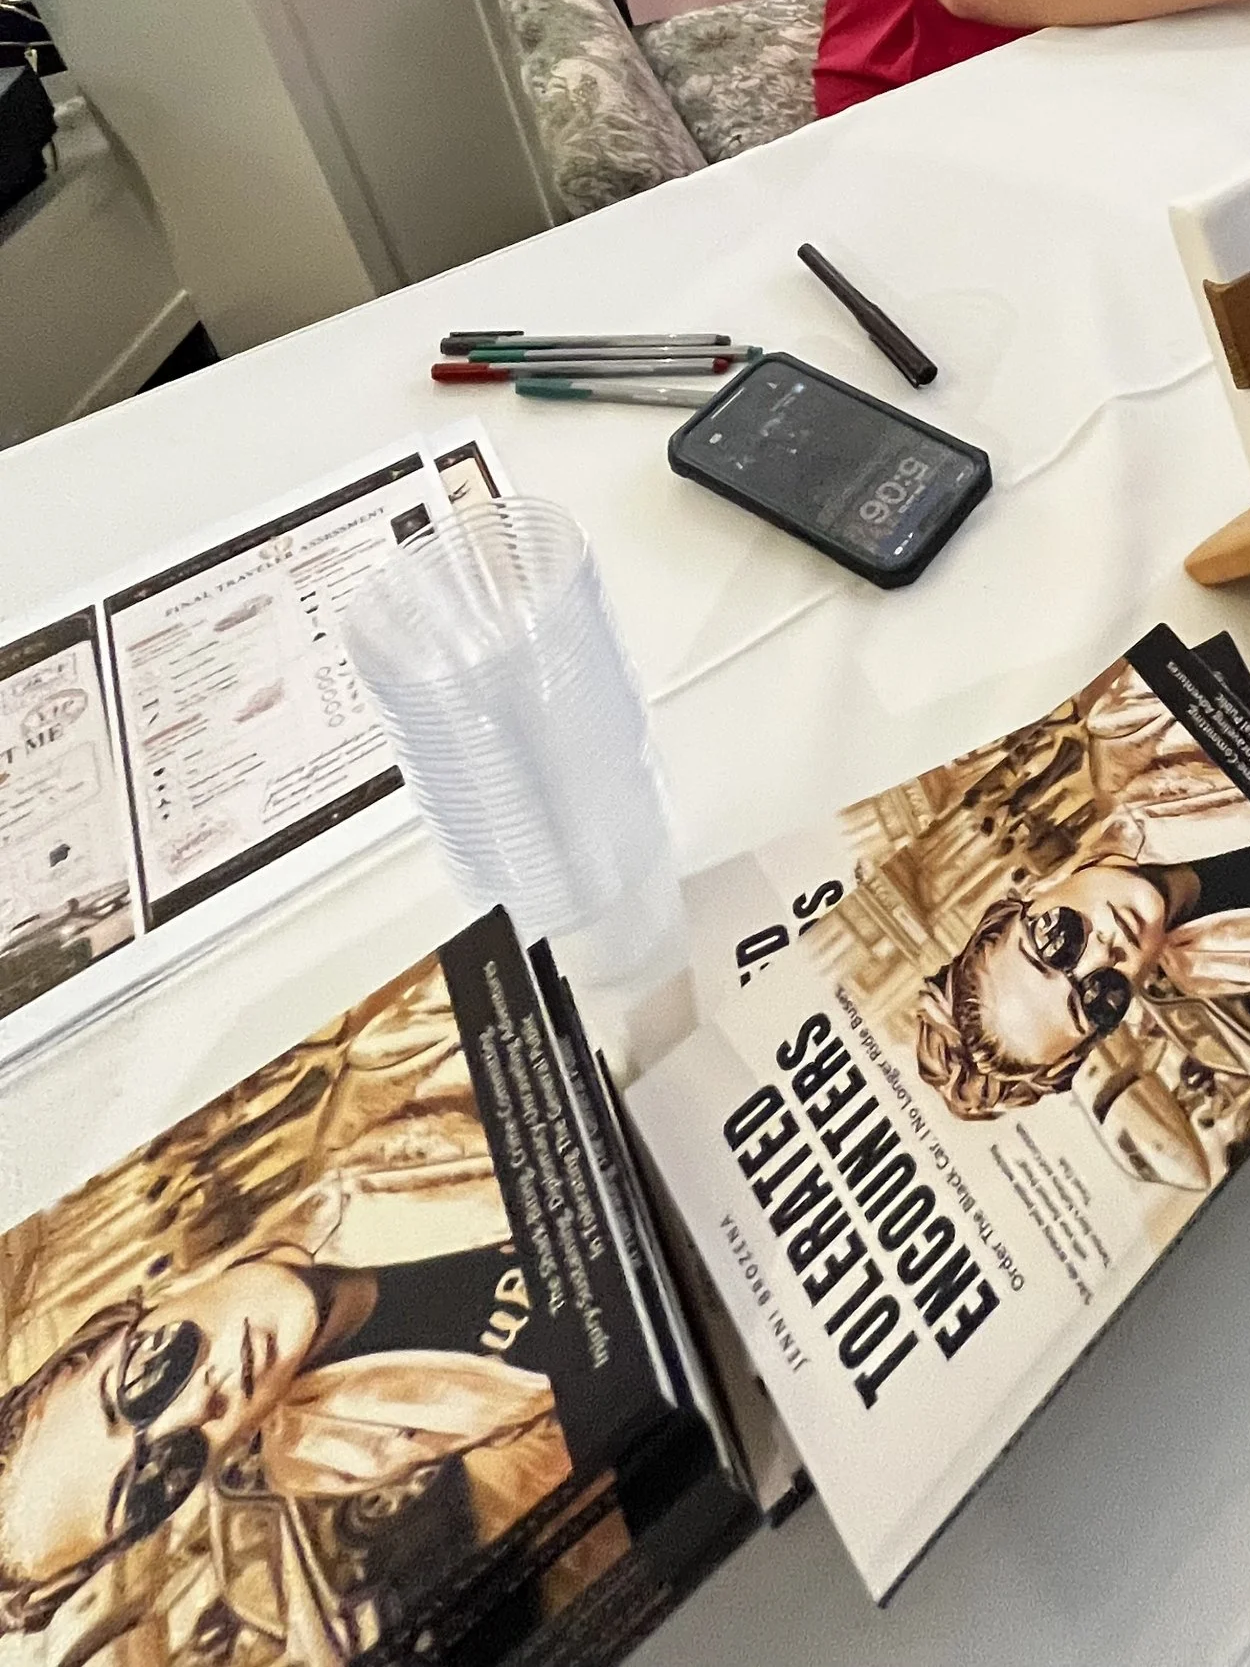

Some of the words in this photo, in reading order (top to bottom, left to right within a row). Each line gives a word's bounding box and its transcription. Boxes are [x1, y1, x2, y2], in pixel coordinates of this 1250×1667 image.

[859, 456, 929, 522] 5:06
[1166, 659, 1214, 715] Adventures
[1214, 691, 1245, 725] Public
[855, 1025, 884, 1061] Ride
[875, 1056, 916, 1110] Longer
[904, 1106, 927, 1132] No
[770, 1010, 1002, 1357] ENCOUNTERS
[941, 1166, 978, 1212] Black
[718, 1081, 920, 1409] TOLERATED
[968, 1209, 998, 1244] The
[986, 1239, 1029, 1292] Order
[542, 1275, 570, 1313] The
[766, 1308, 809, 1373] JENNI
